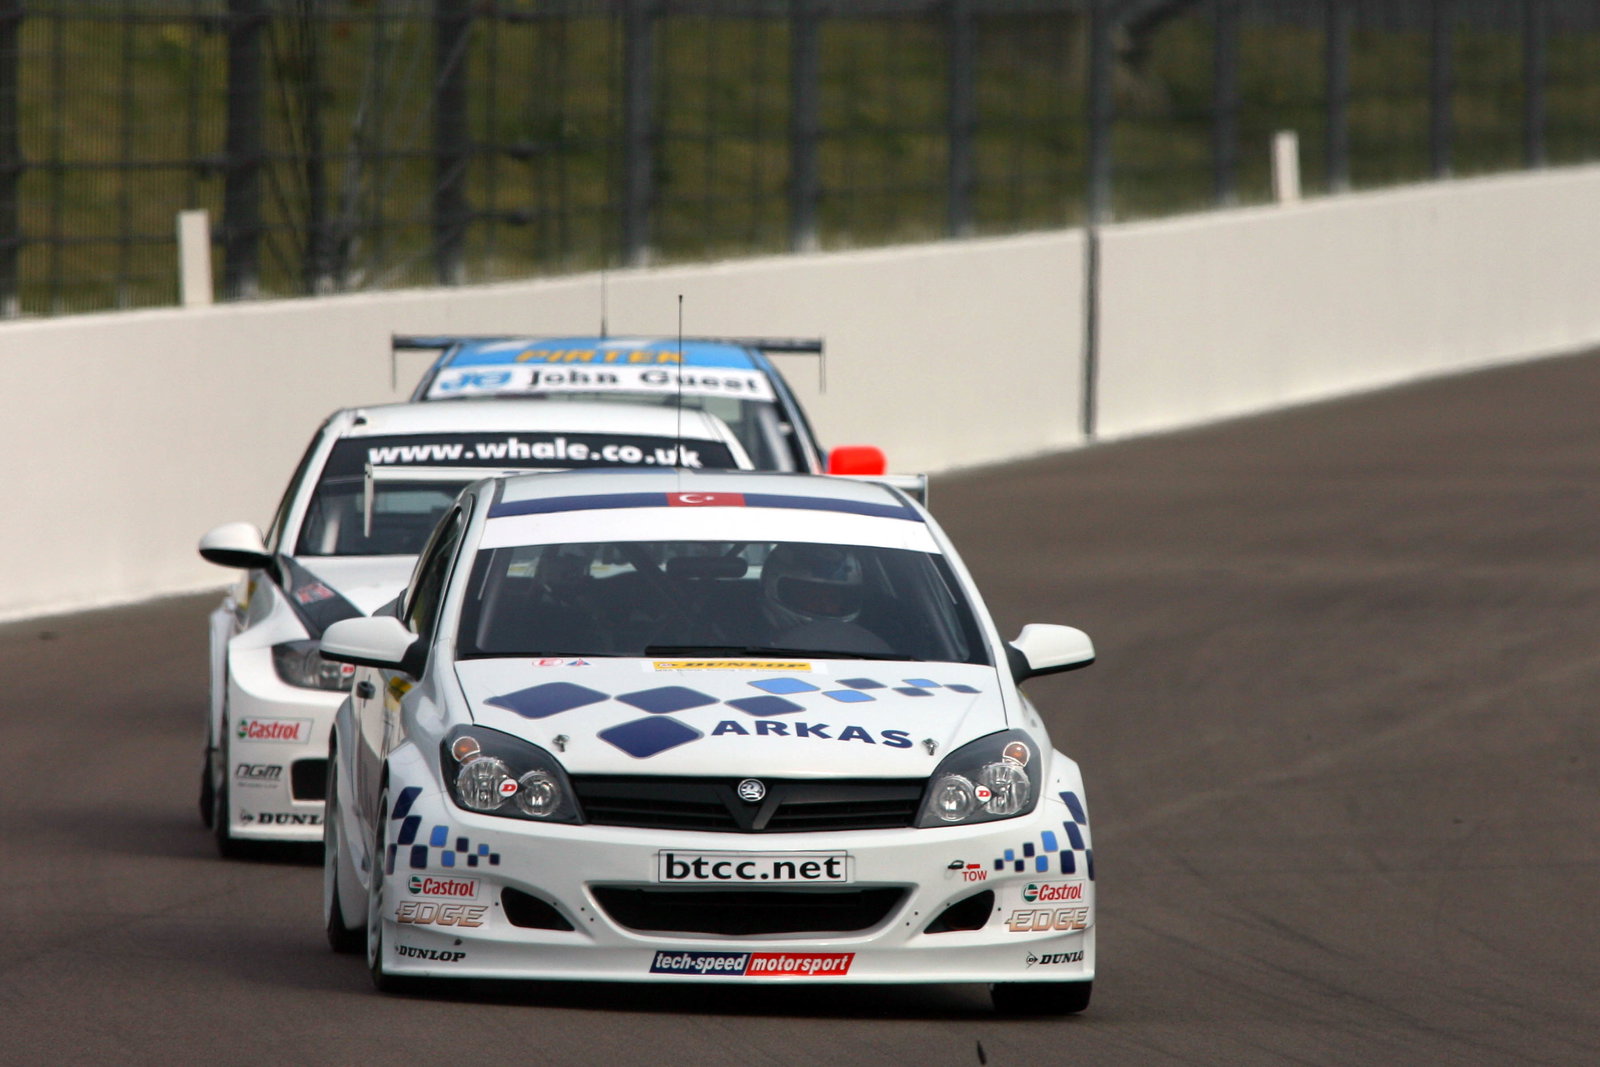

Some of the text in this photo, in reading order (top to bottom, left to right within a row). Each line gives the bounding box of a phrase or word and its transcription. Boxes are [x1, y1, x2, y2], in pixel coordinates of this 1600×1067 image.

[527, 368, 618, 387] John
[639, 369, 759, 392] Guest
[369, 437, 703, 469] www.whale.co.uk
[248, 720, 300, 739] Castrol
[711, 720, 913, 749] ARKAS
[257, 813, 324, 825] DUNL
[666, 853, 841, 880] btcc.net
[962, 870, 987, 881] TOW
[423, 878, 474, 896] Castrol
[1039, 884, 1082, 901] Castrol
[395, 901, 488, 927] EDGE
[1004, 906, 1089, 932] EDGE
[398, 945, 466, 962] DUNLOP
[1039, 950, 1084, 965] DUNLO
[656, 953, 849, 975] tech-speed motorsport
